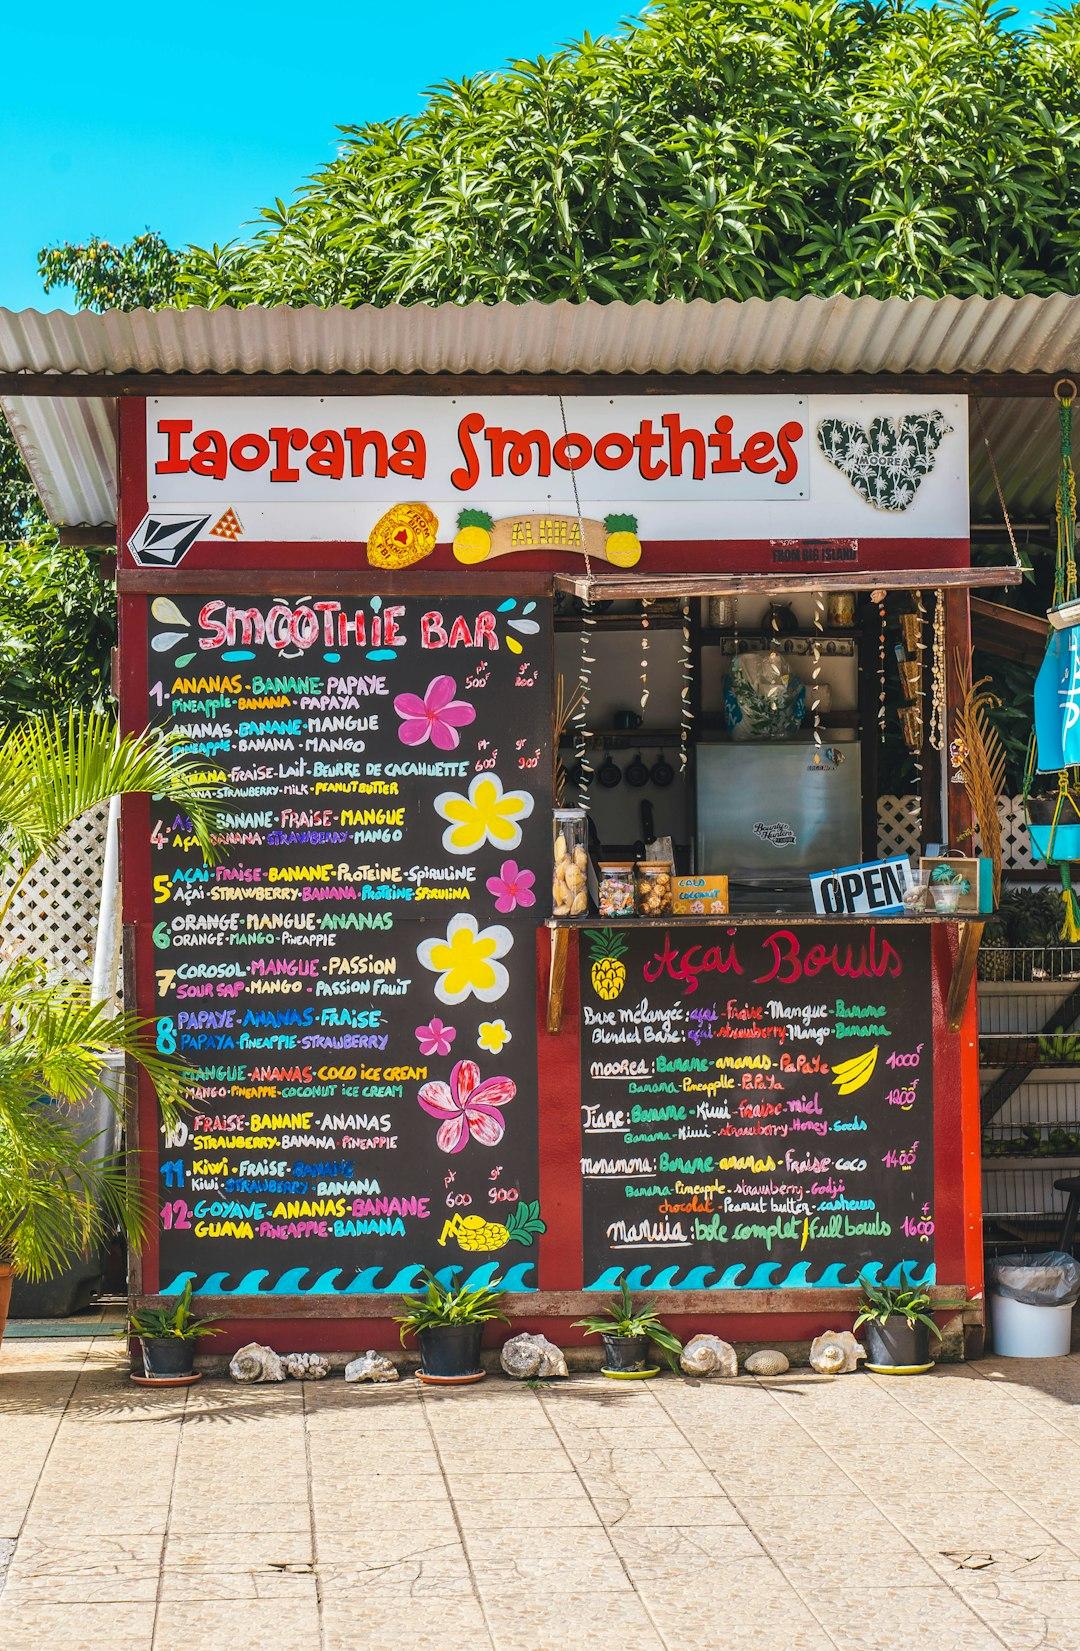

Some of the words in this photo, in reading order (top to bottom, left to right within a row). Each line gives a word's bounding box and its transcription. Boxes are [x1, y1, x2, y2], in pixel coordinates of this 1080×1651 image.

[155, 419, 427, 482] Iaorana
[451, 412, 803, 490] Smoothies
[857, 455, 909, 468] MOOREA
[377, 543, 391, 559] FBI
[421, 611, 499, 650] BAR
[171, 674, 242, 694] ANANAS
[252, 676, 321, 695] BANANE
[327, 674, 389, 695] PAPAYE
[237, 696, 291, 709] BANANA
[300, 695, 360, 709] PAPAYA
[172, 723, 233, 739] ANANAS
[238, 719, 302, 736] BANANE
[307, 715, 379, 732] MANGUE
[238, 739, 294, 752] BANANA
[305, 738, 365, 752] MANGO
[313, 761, 360, 780] BEURRE
[365, 763, 381, 777] DE
[384, 761, 470, 777] CACAHUETTE
[216, 786, 279, 798] STRAWBERRY
[216, 810, 273, 830] BANANE
[341, 807, 405, 827] MANGUE
[209, 832, 263, 846] BANANA
[266, 831, 348, 846] STRAWBERRY
[353, 829, 403, 844] MANGO
[268, 864, 334, 882] BANANE
[210, 885, 300, 901] STRAWBERRY
[301, 885, 356, 901] BANANA
[820, 862, 904, 915] OPEN
[171, 913, 240, 932] ORANGE
[247, 912, 316, 931] MANGUE
[320, 911, 394, 931] ANANAS
[172, 932, 225, 947] ORANGE
[229, 932, 275, 945] MANGO
[177, 963, 247, 979] COROSOL
[250, 959, 320, 977] MANGUE
[177, 983, 214, 1000] SOUR
[216, 980, 246, 997] SAP
[250, 979, 303, 995] MANGO
[177, 1008, 237, 1030] PAPAYE
[243, 1007, 315, 1030] ANANAS
[766, 1000, 828, 1027] Mangue
[835, 999, 887, 1019] Banane
[180, 1034, 237, 1051] PAPAYA
[301, 1033, 389, 1051] STRAWBERRY
[592, 1026, 642, 1044] Blended
[787, 1024, 830, 1046] Mango
[835, 1022, 892, 1039] Banana
[656, 1056, 710, 1073] Banane
[715, 1055, 772, 1072] ananas
[250, 1066, 314, 1084] ANANAS
[316, 1066, 357, 1081] COCO
[383, 1066, 428, 1081] CREAM
[185, 1087, 227, 1100] MANGO
[281, 1085, 338, 1099] COCONUT
[362, 1085, 403, 1099] CREAM
[628, 1082, 680, 1095] Banana
[631, 1104, 687, 1124] Banane
[696, 1099, 732, 1122] Kiwi
[250, 1112, 314, 1132] BANANE
[320, 1113, 391, 1132] ANANAS
[623, 1131, 674, 1145] Banana
[678, 1124, 712, 1141] Kiwi
[791, 1118, 828, 1137] Honey
[193, 1136, 278, 1151] STRAWBERRY
[281, 1136, 336, 1150] BANANA
[659, 1152, 715, 1174] Banane
[718, 1155, 776, 1174] ananas
[784, 1148, 832, 1174] Fraise
[225, 1180, 308, 1195] STRAWBERRY
[317, 1178, 381, 1197] BANANA
[488, 1187, 519, 1205] 900
[624, 1185, 672, 1198] Banana
[674, 1179, 727, 1201] Pineapple
[733, 1178, 804, 1202] strawberry
[193, 1200, 268, 1220] GOYAVE
[272, 1198, 346, 1219] ANANAS
[351, 1196, 431, 1219] BANANE
[445, 1191, 472, 1208] 600
[658, 1194, 714, 1214] chocolat
[723, 1197, 768, 1214] Peanut
[770, 1198, 813, 1216] butter
[194, 1221, 254, 1240] GUAVA
[333, 1218, 406, 1238] BANANA
[731, 1215, 802, 1251] complet
